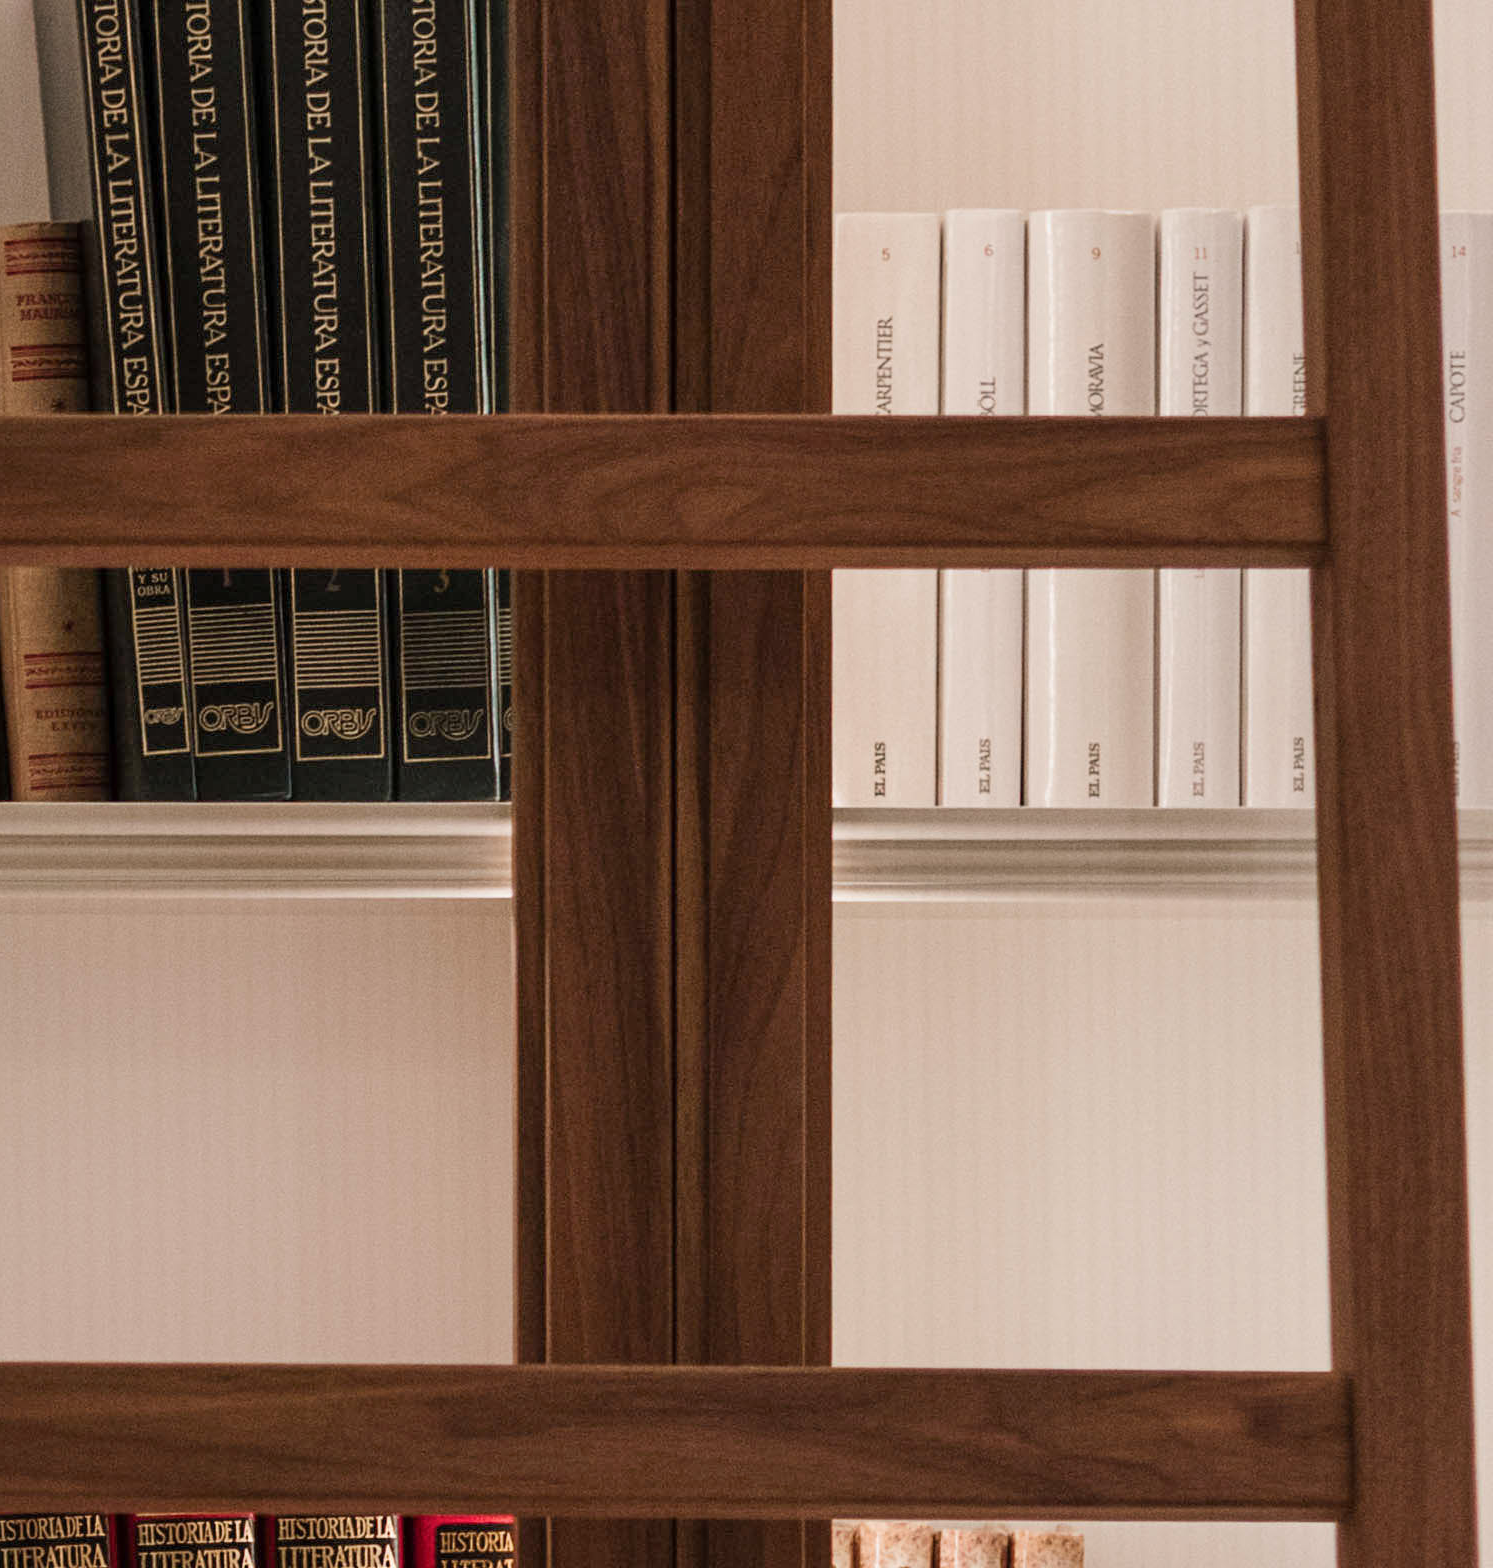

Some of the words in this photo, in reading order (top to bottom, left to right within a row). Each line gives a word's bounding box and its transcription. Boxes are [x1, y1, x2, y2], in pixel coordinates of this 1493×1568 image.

[306, 92, 330, 131] DE
[308, 137, 331, 174] LA
[310, 180, 339, 354] LITERATURA
